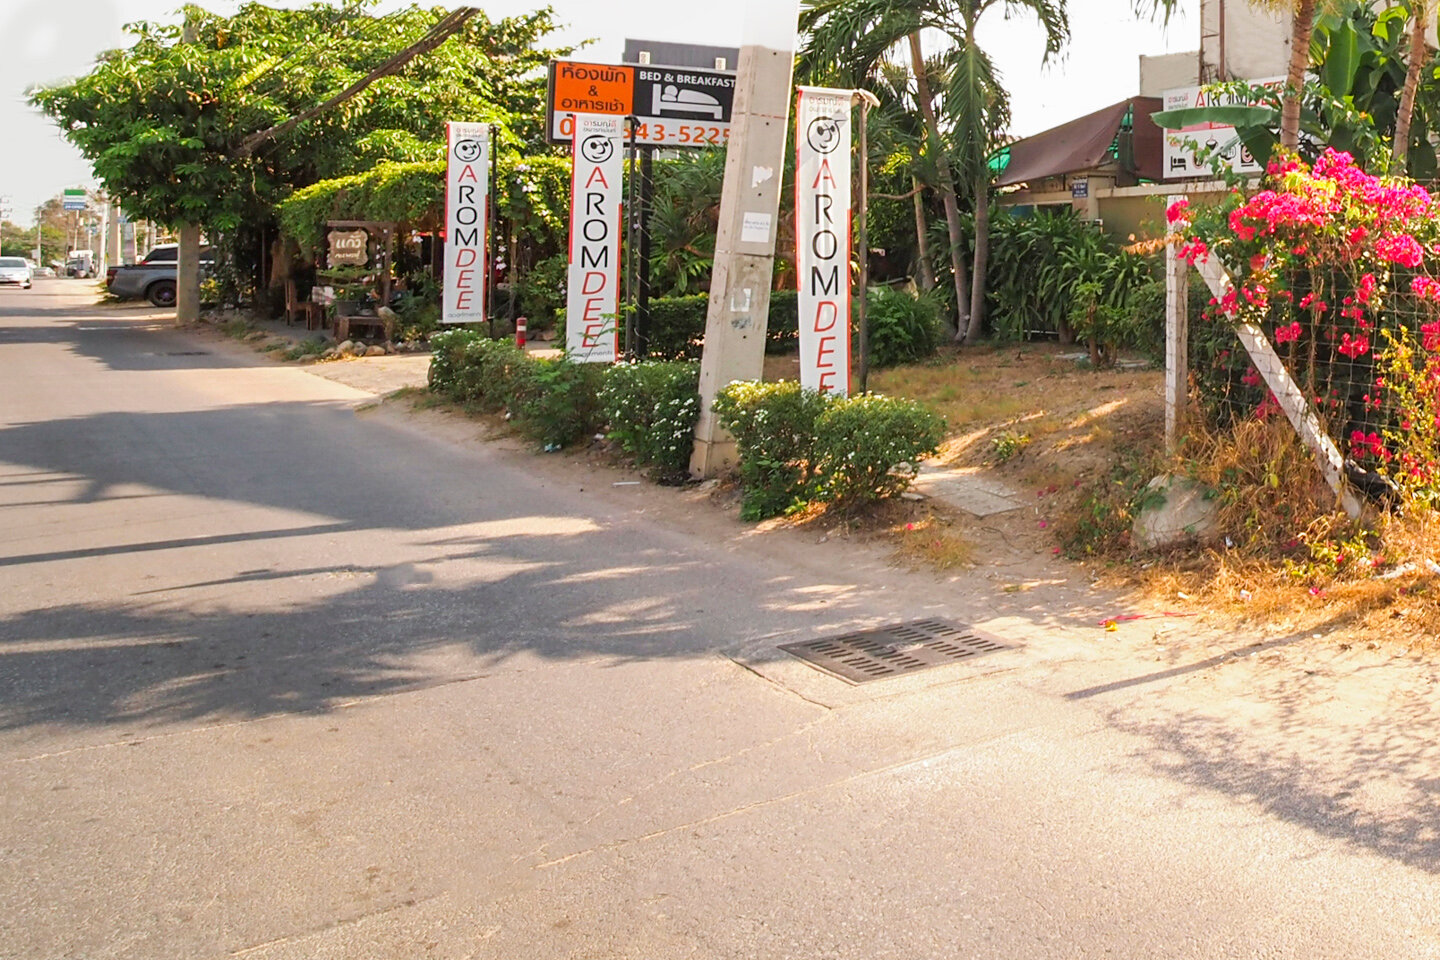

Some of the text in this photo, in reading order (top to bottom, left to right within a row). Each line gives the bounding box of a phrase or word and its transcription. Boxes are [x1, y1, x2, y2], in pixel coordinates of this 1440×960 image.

[562, 63, 626, 83] ห้องพัก
[639, 71, 736, 88] BED & BREAKFAST
[588, 85, 598, 96] &
[562, 98, 625, 112] อาหารเช้า
[455, 164, 478, 309] AROMDEE
[581, 166, 609, 348] AROMDEE
[811, 159, 838, 394] AROMDEE
